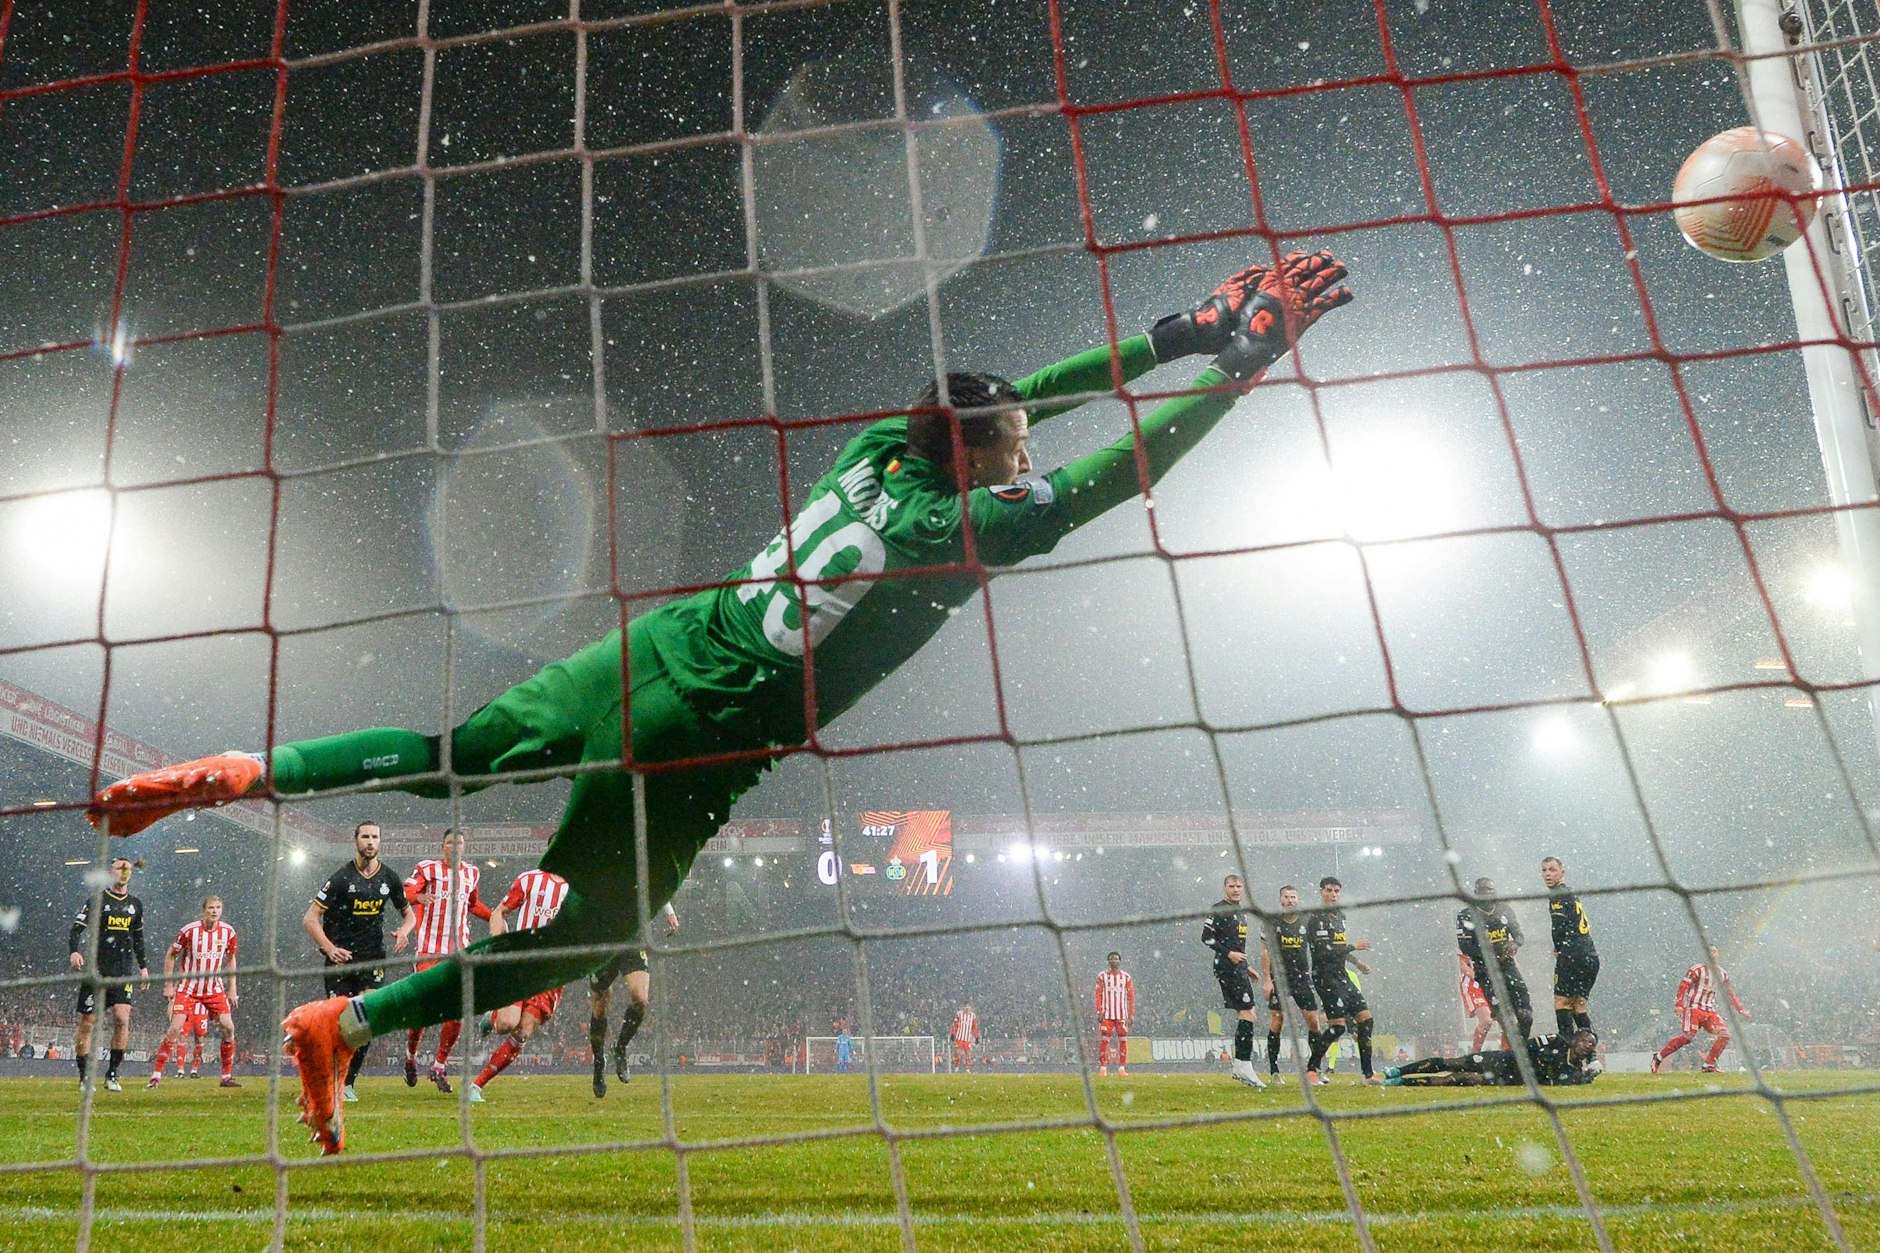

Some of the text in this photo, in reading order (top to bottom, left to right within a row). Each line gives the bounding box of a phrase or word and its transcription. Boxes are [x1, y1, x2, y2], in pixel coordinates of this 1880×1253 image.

[862, 825, 895, 837] 41:27
[817, 851, 842, 885] 0
[920, 850, 938, 884] 1
[353, 899, 384, 912] hey!
[108, 915, 132, 928] hey!
